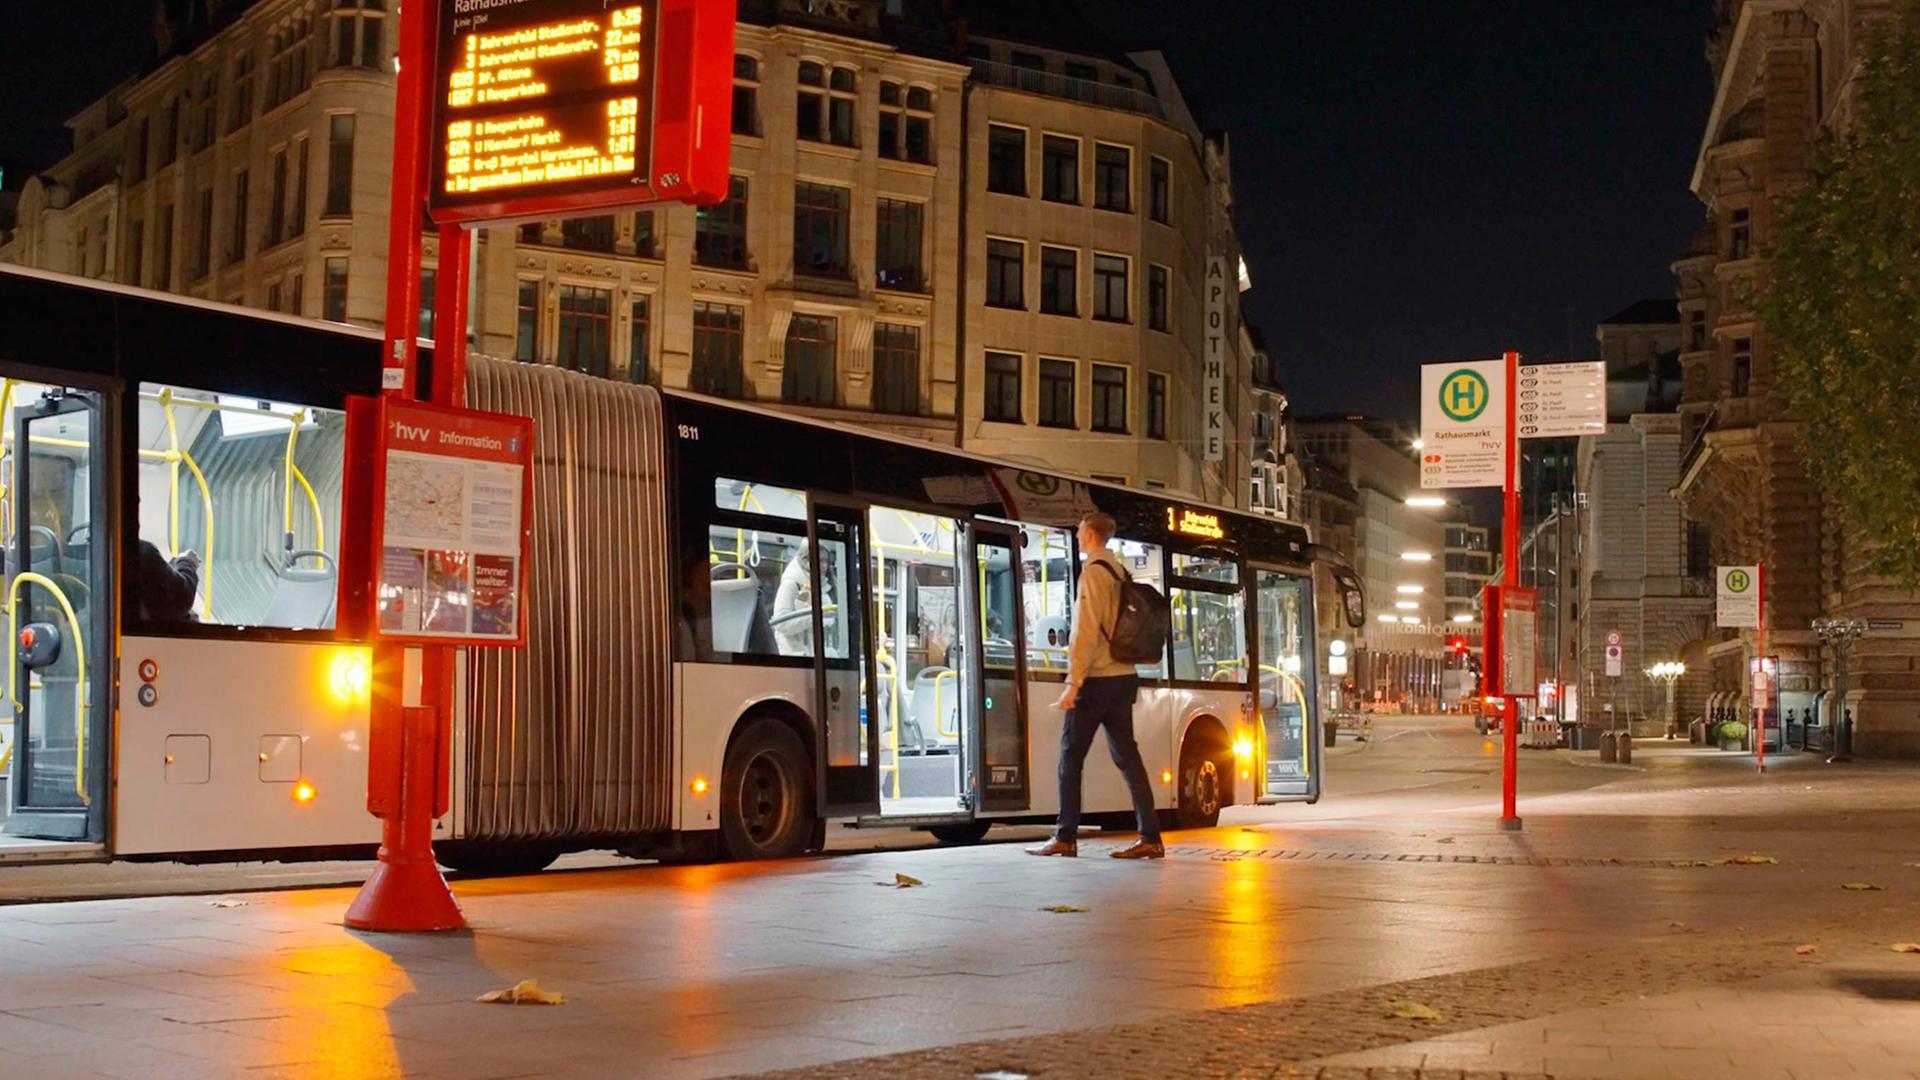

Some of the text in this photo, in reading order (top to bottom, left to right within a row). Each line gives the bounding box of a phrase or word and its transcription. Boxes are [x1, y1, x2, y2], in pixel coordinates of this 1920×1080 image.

[1207, 261, 1223, 454] APOTHEKE
[1452, 380, 1475, 410] H
[396, 421, 502, 450] hvv Information
[678, 424, 699, 440] 1811
[1435, 430, 1491, 440] Rathausmarkt
